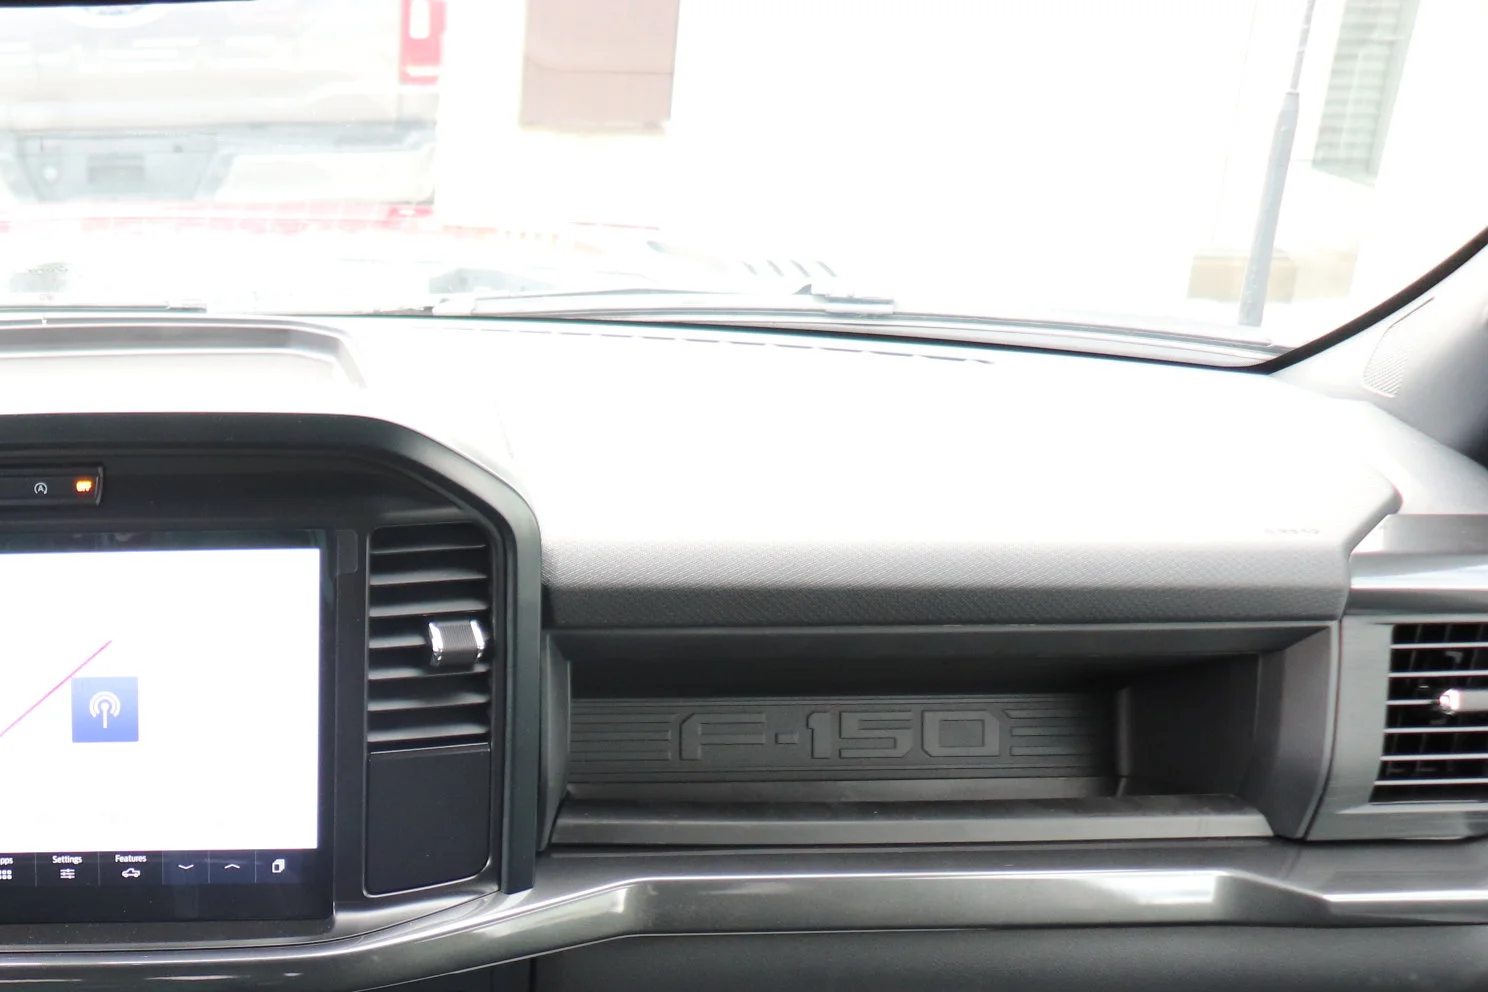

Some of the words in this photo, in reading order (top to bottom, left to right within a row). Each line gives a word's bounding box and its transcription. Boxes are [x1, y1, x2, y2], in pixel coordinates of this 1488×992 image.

[75, 480, 92, 492] OFF
[679, 710, 1001, 761] F-150
[52, 855, 83, 865] Settings
[115, 854, 147, 864] Features
